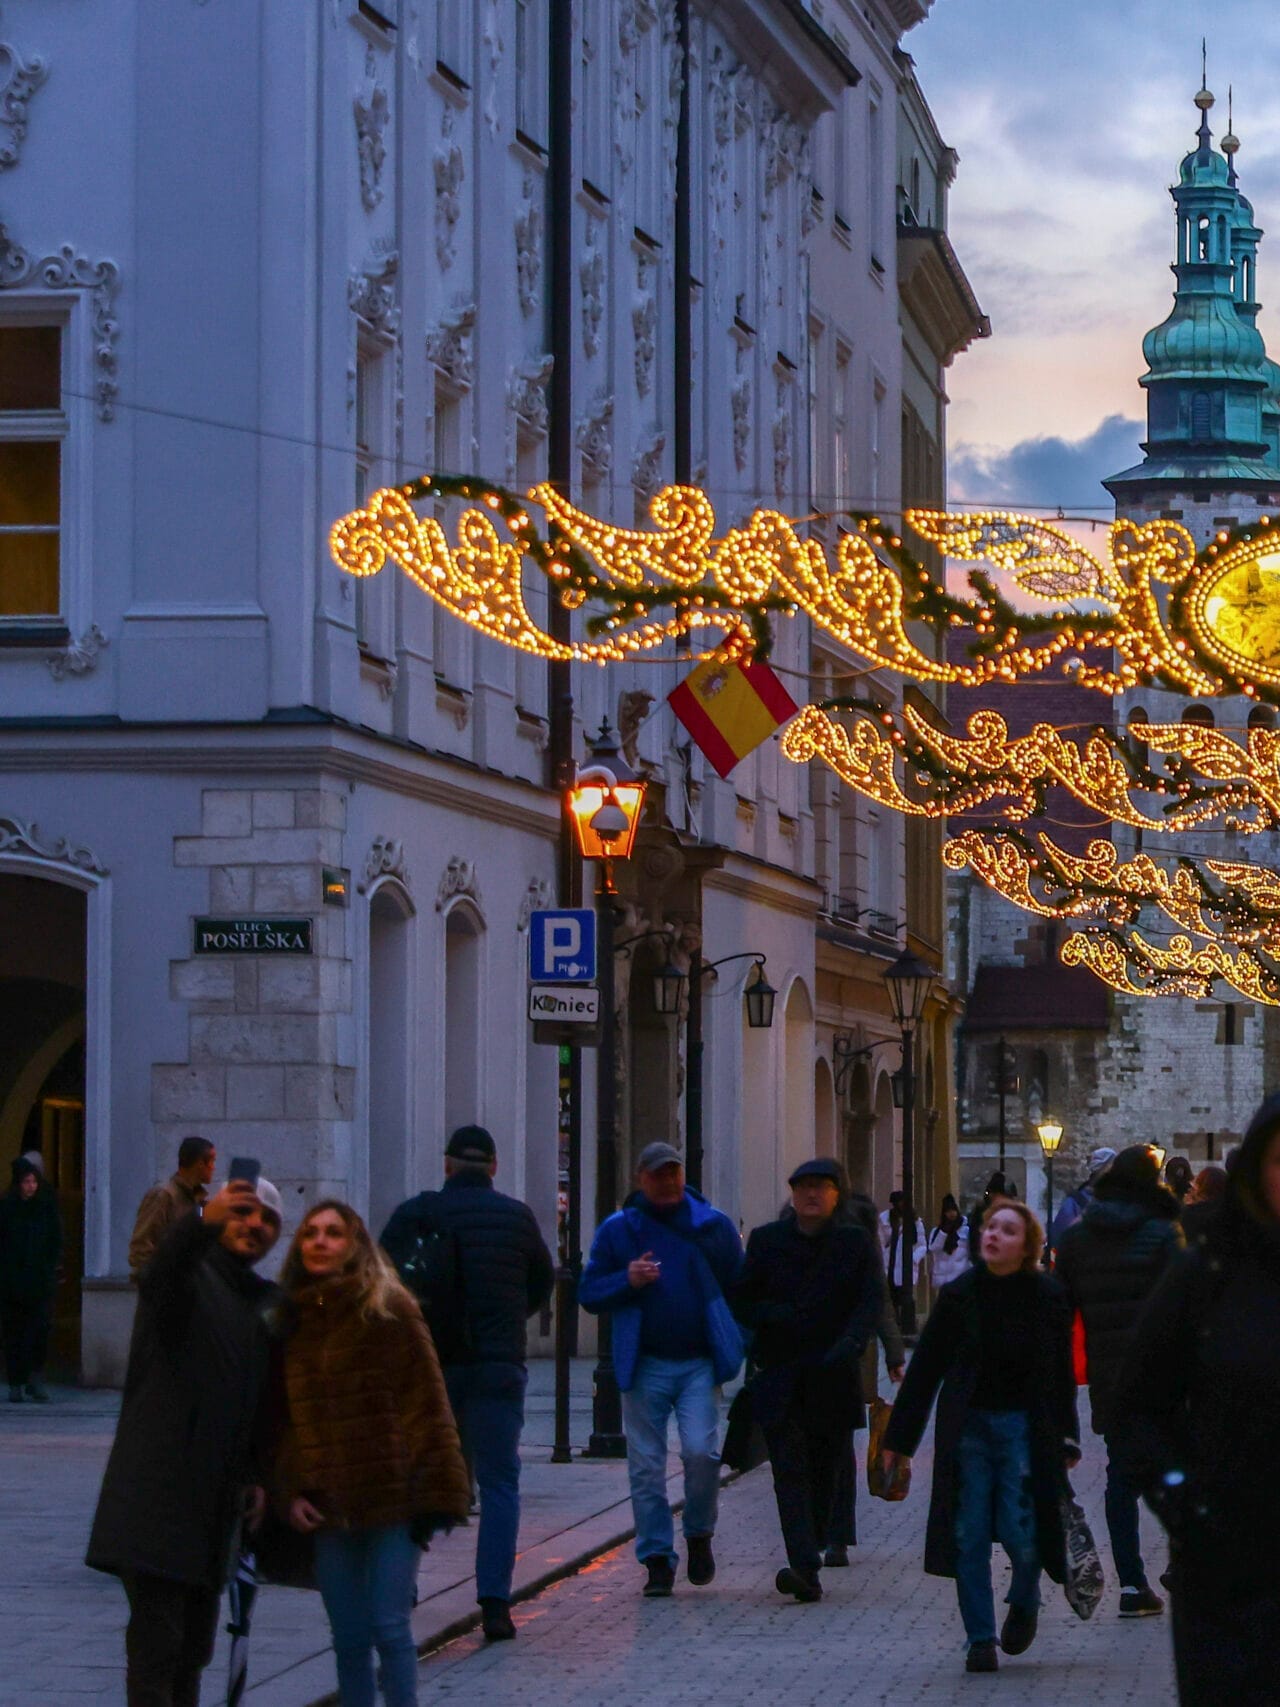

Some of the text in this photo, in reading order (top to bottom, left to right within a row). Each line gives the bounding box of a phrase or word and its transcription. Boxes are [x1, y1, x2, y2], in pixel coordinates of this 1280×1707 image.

[234, 922, 271, 932] ULICA
[202, 933, 305, 949] POSELSKA
[543, 917, 581, 973] P
[532, 995, 596, 1013] Kniec
